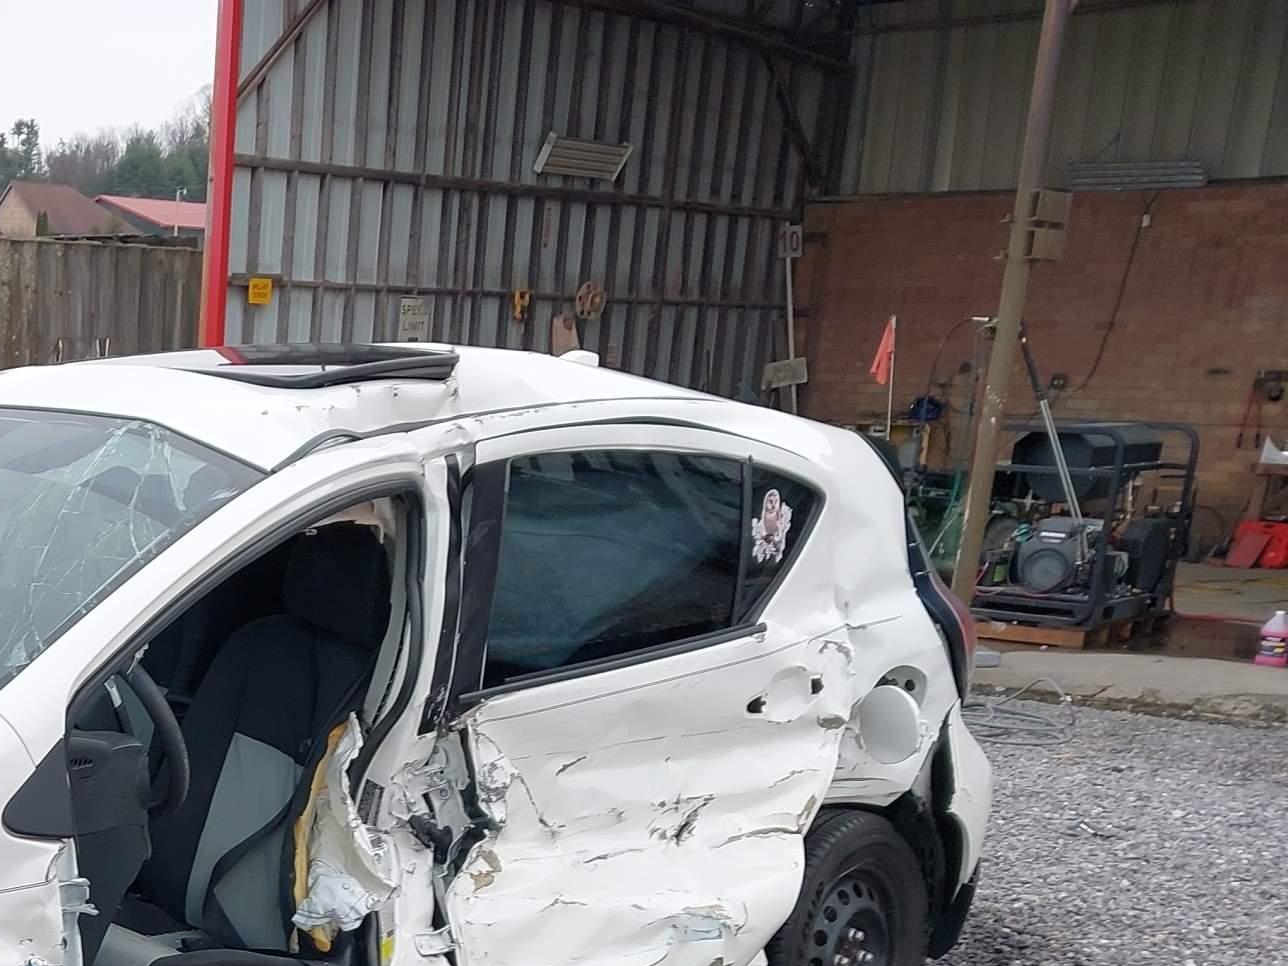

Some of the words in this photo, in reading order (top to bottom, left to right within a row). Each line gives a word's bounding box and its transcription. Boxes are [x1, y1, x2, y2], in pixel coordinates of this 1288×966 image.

[776, 230, 799, 252] 10
[402, 304, 427, 315] SPE
[402, 319, 425, 331] LIMIT
